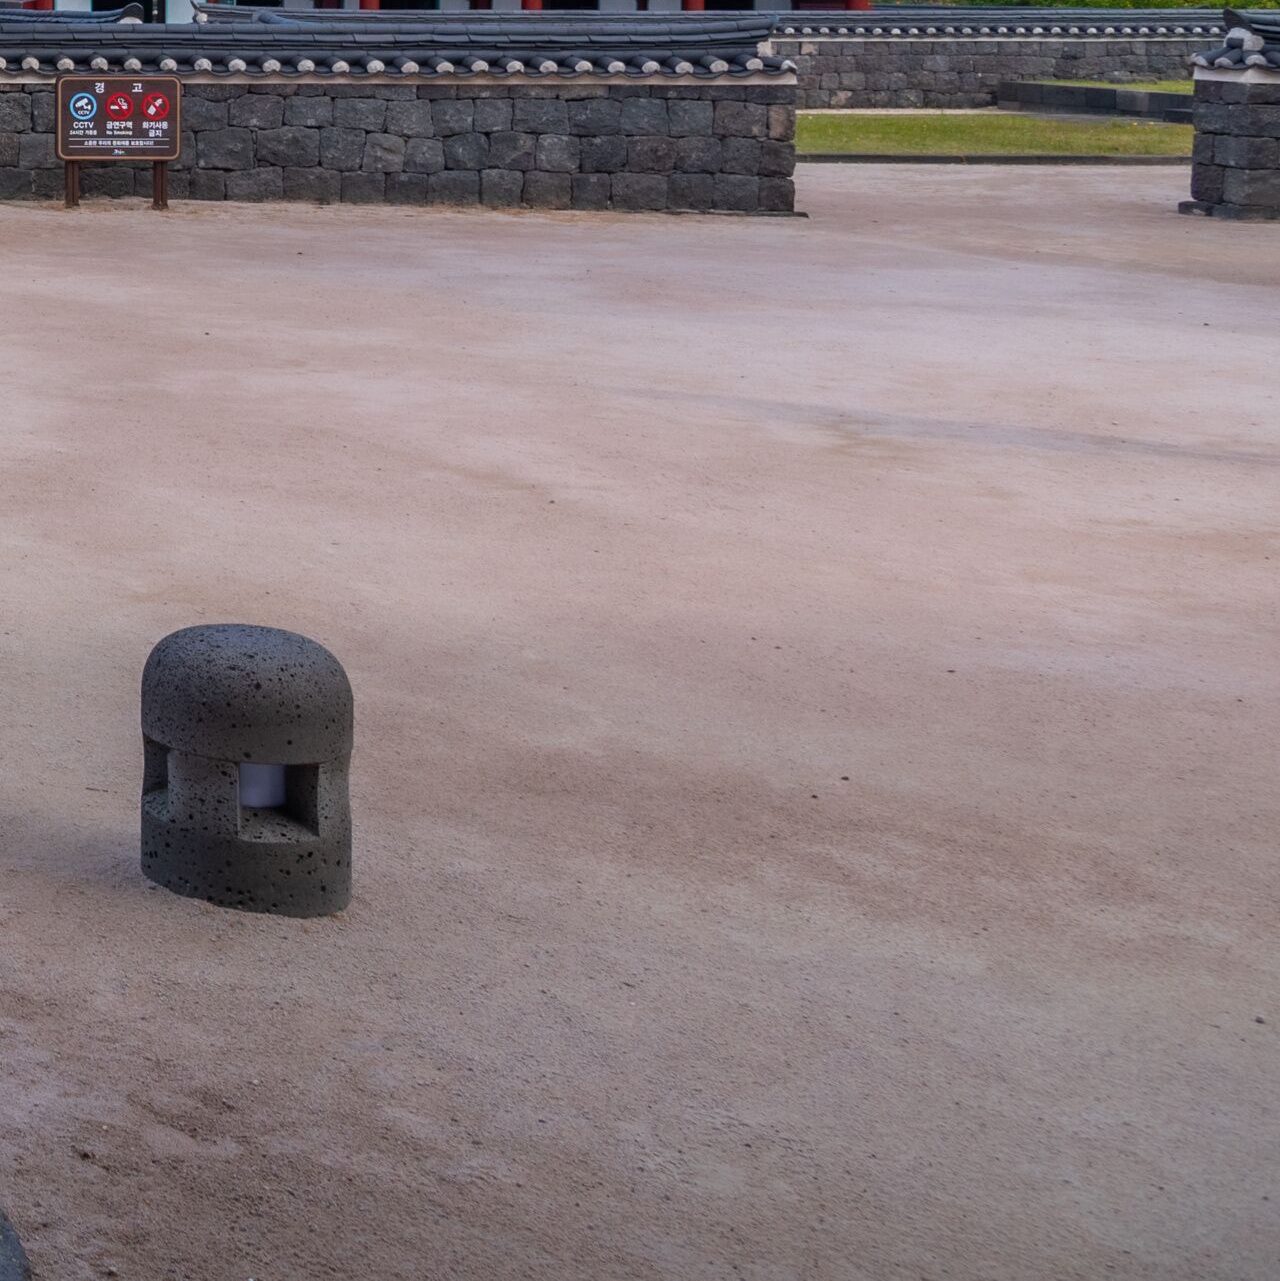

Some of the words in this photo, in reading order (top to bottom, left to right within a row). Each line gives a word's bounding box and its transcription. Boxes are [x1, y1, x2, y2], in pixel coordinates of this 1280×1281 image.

[132, 83, 143, 93] 고
[73, 121, 94, 129] CCTV
[106, 121, 133, 129] 금연구역
[142, 121, 169, 129] 화기사용
